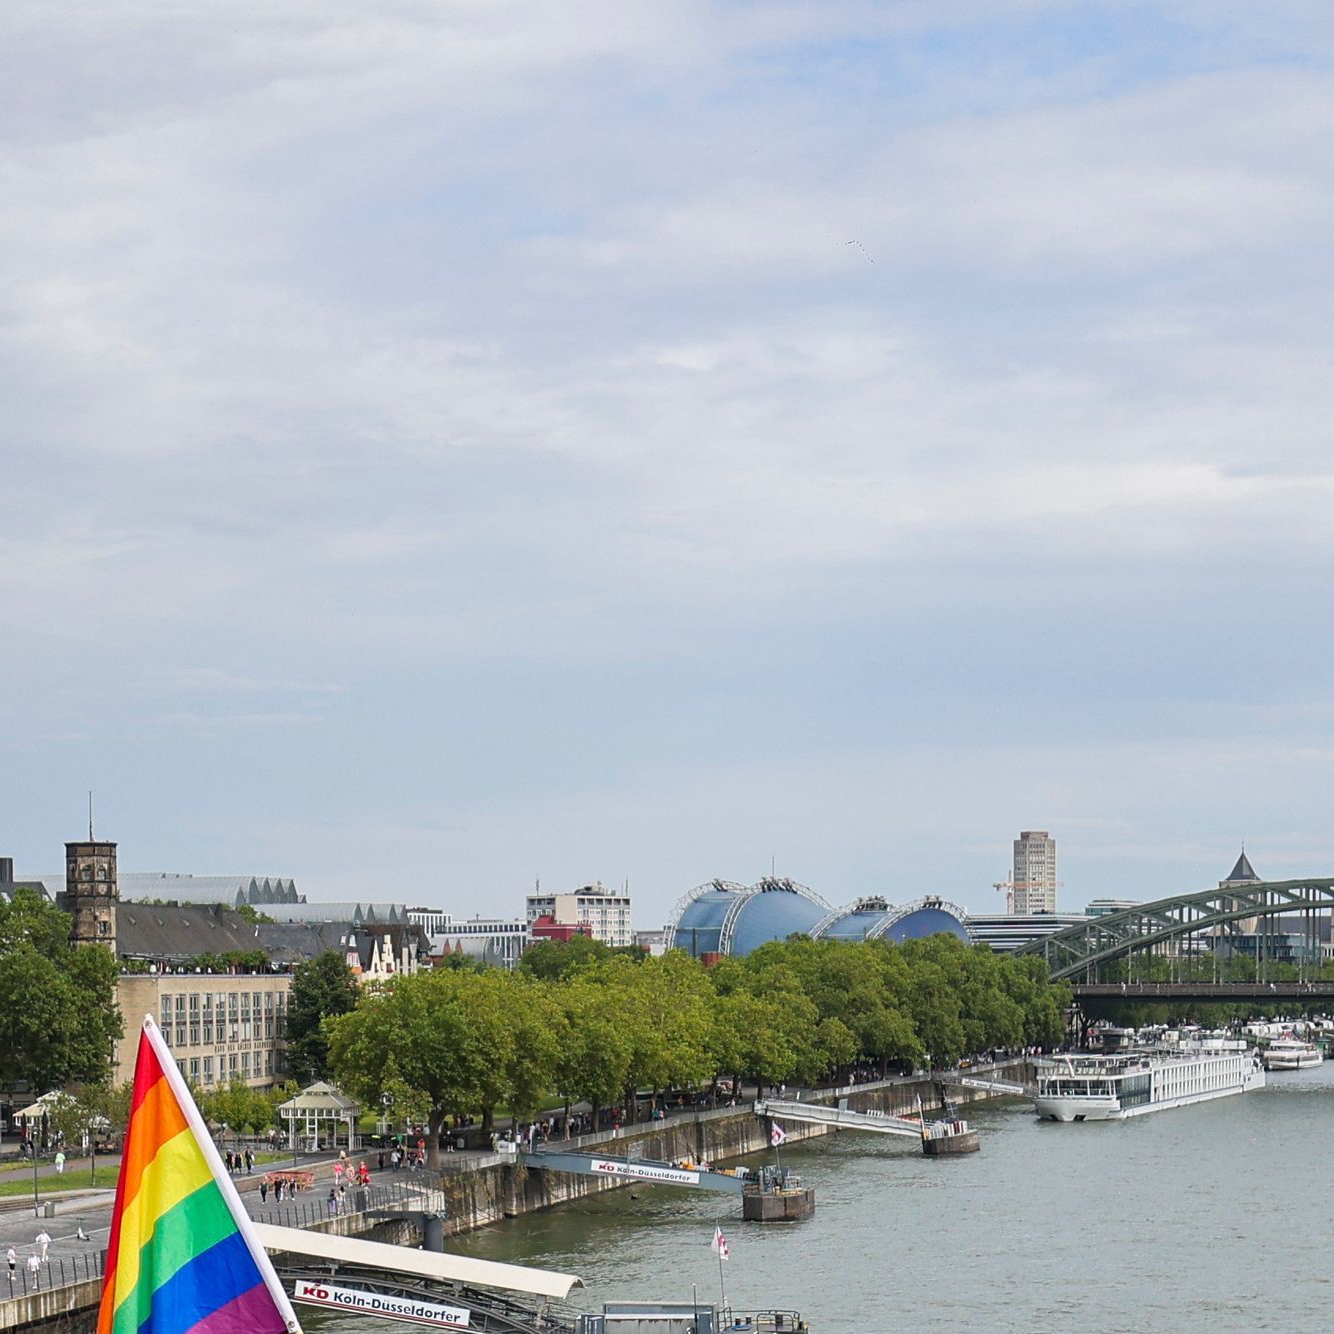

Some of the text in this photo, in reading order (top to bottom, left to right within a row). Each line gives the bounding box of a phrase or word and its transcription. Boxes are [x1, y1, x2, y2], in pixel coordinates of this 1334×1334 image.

[598, 1162, 691, 1182] KD Kön-Düsseldorfer
[303, 1284, 461, 1323] KD Köln-Düsseldorfer
